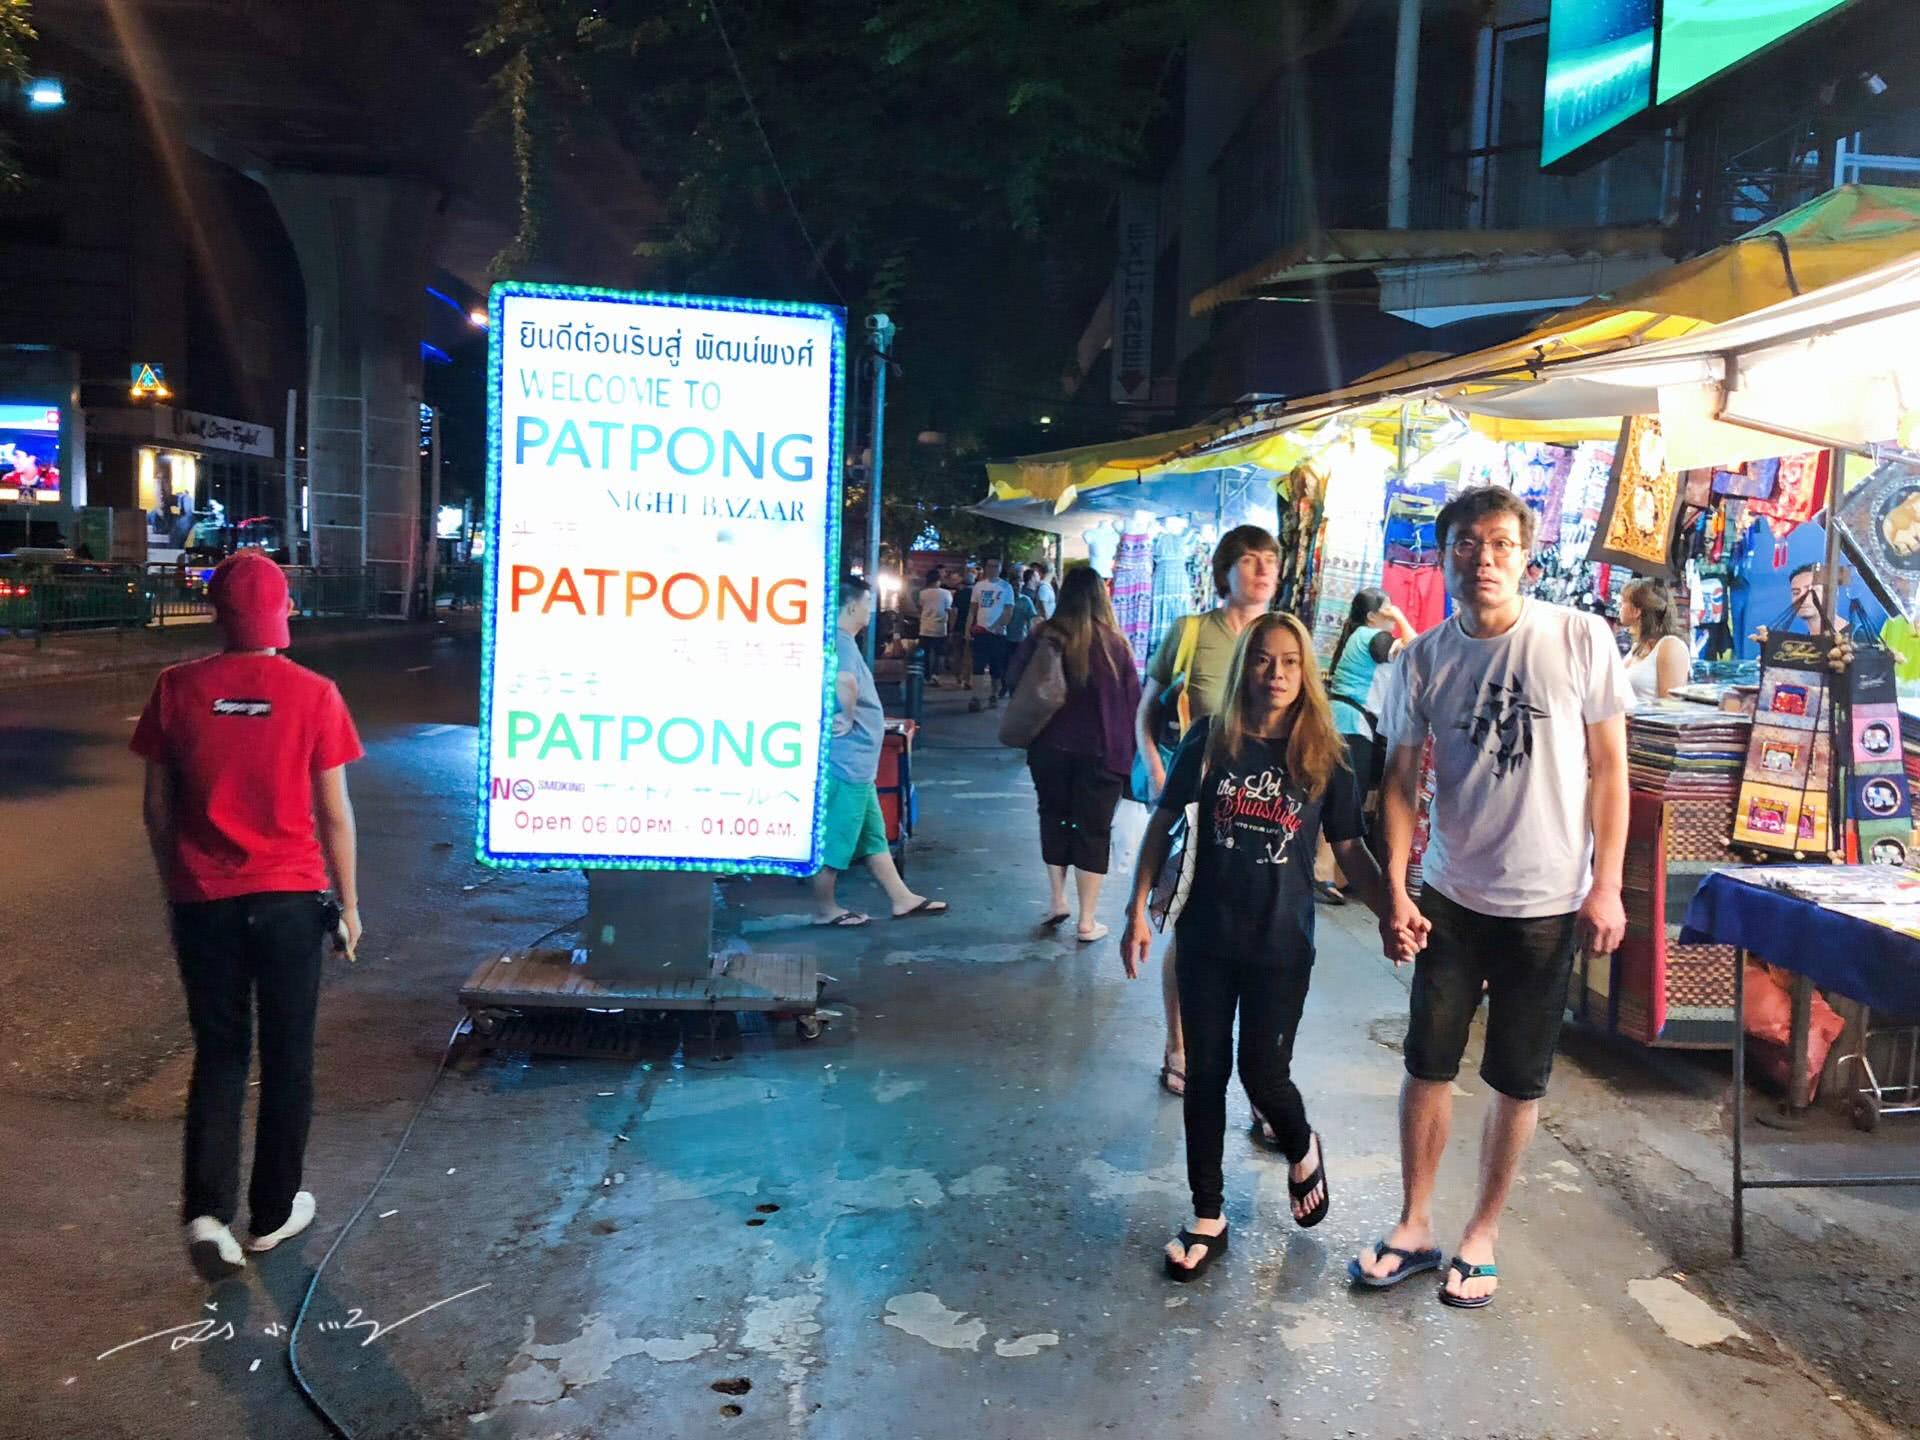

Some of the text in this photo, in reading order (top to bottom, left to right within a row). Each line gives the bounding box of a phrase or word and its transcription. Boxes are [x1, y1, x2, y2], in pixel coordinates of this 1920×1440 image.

[520, 321, 682, 366] ยินดีต้อนรับสู่
[519, 368, 721, 411] WELCOME TO
[515, 415, 814, 482] PATPONG
[606, 489, 806, 522] NIGHT BAZAAR
[511, 564, 808, 625] PATPONG
[507, 710, 802, 768] PATPONG
[537, 780, 586, 793] SMOKING
[1216, 778, 1237, 796] the
[1244, 770, 1282, 801] Let
[514, 810, 572, 832] Open
[582, 815, 642, 834] 0600
[646, 819, 673, 833] PM
[701, 817, 760, 836] 01.00
